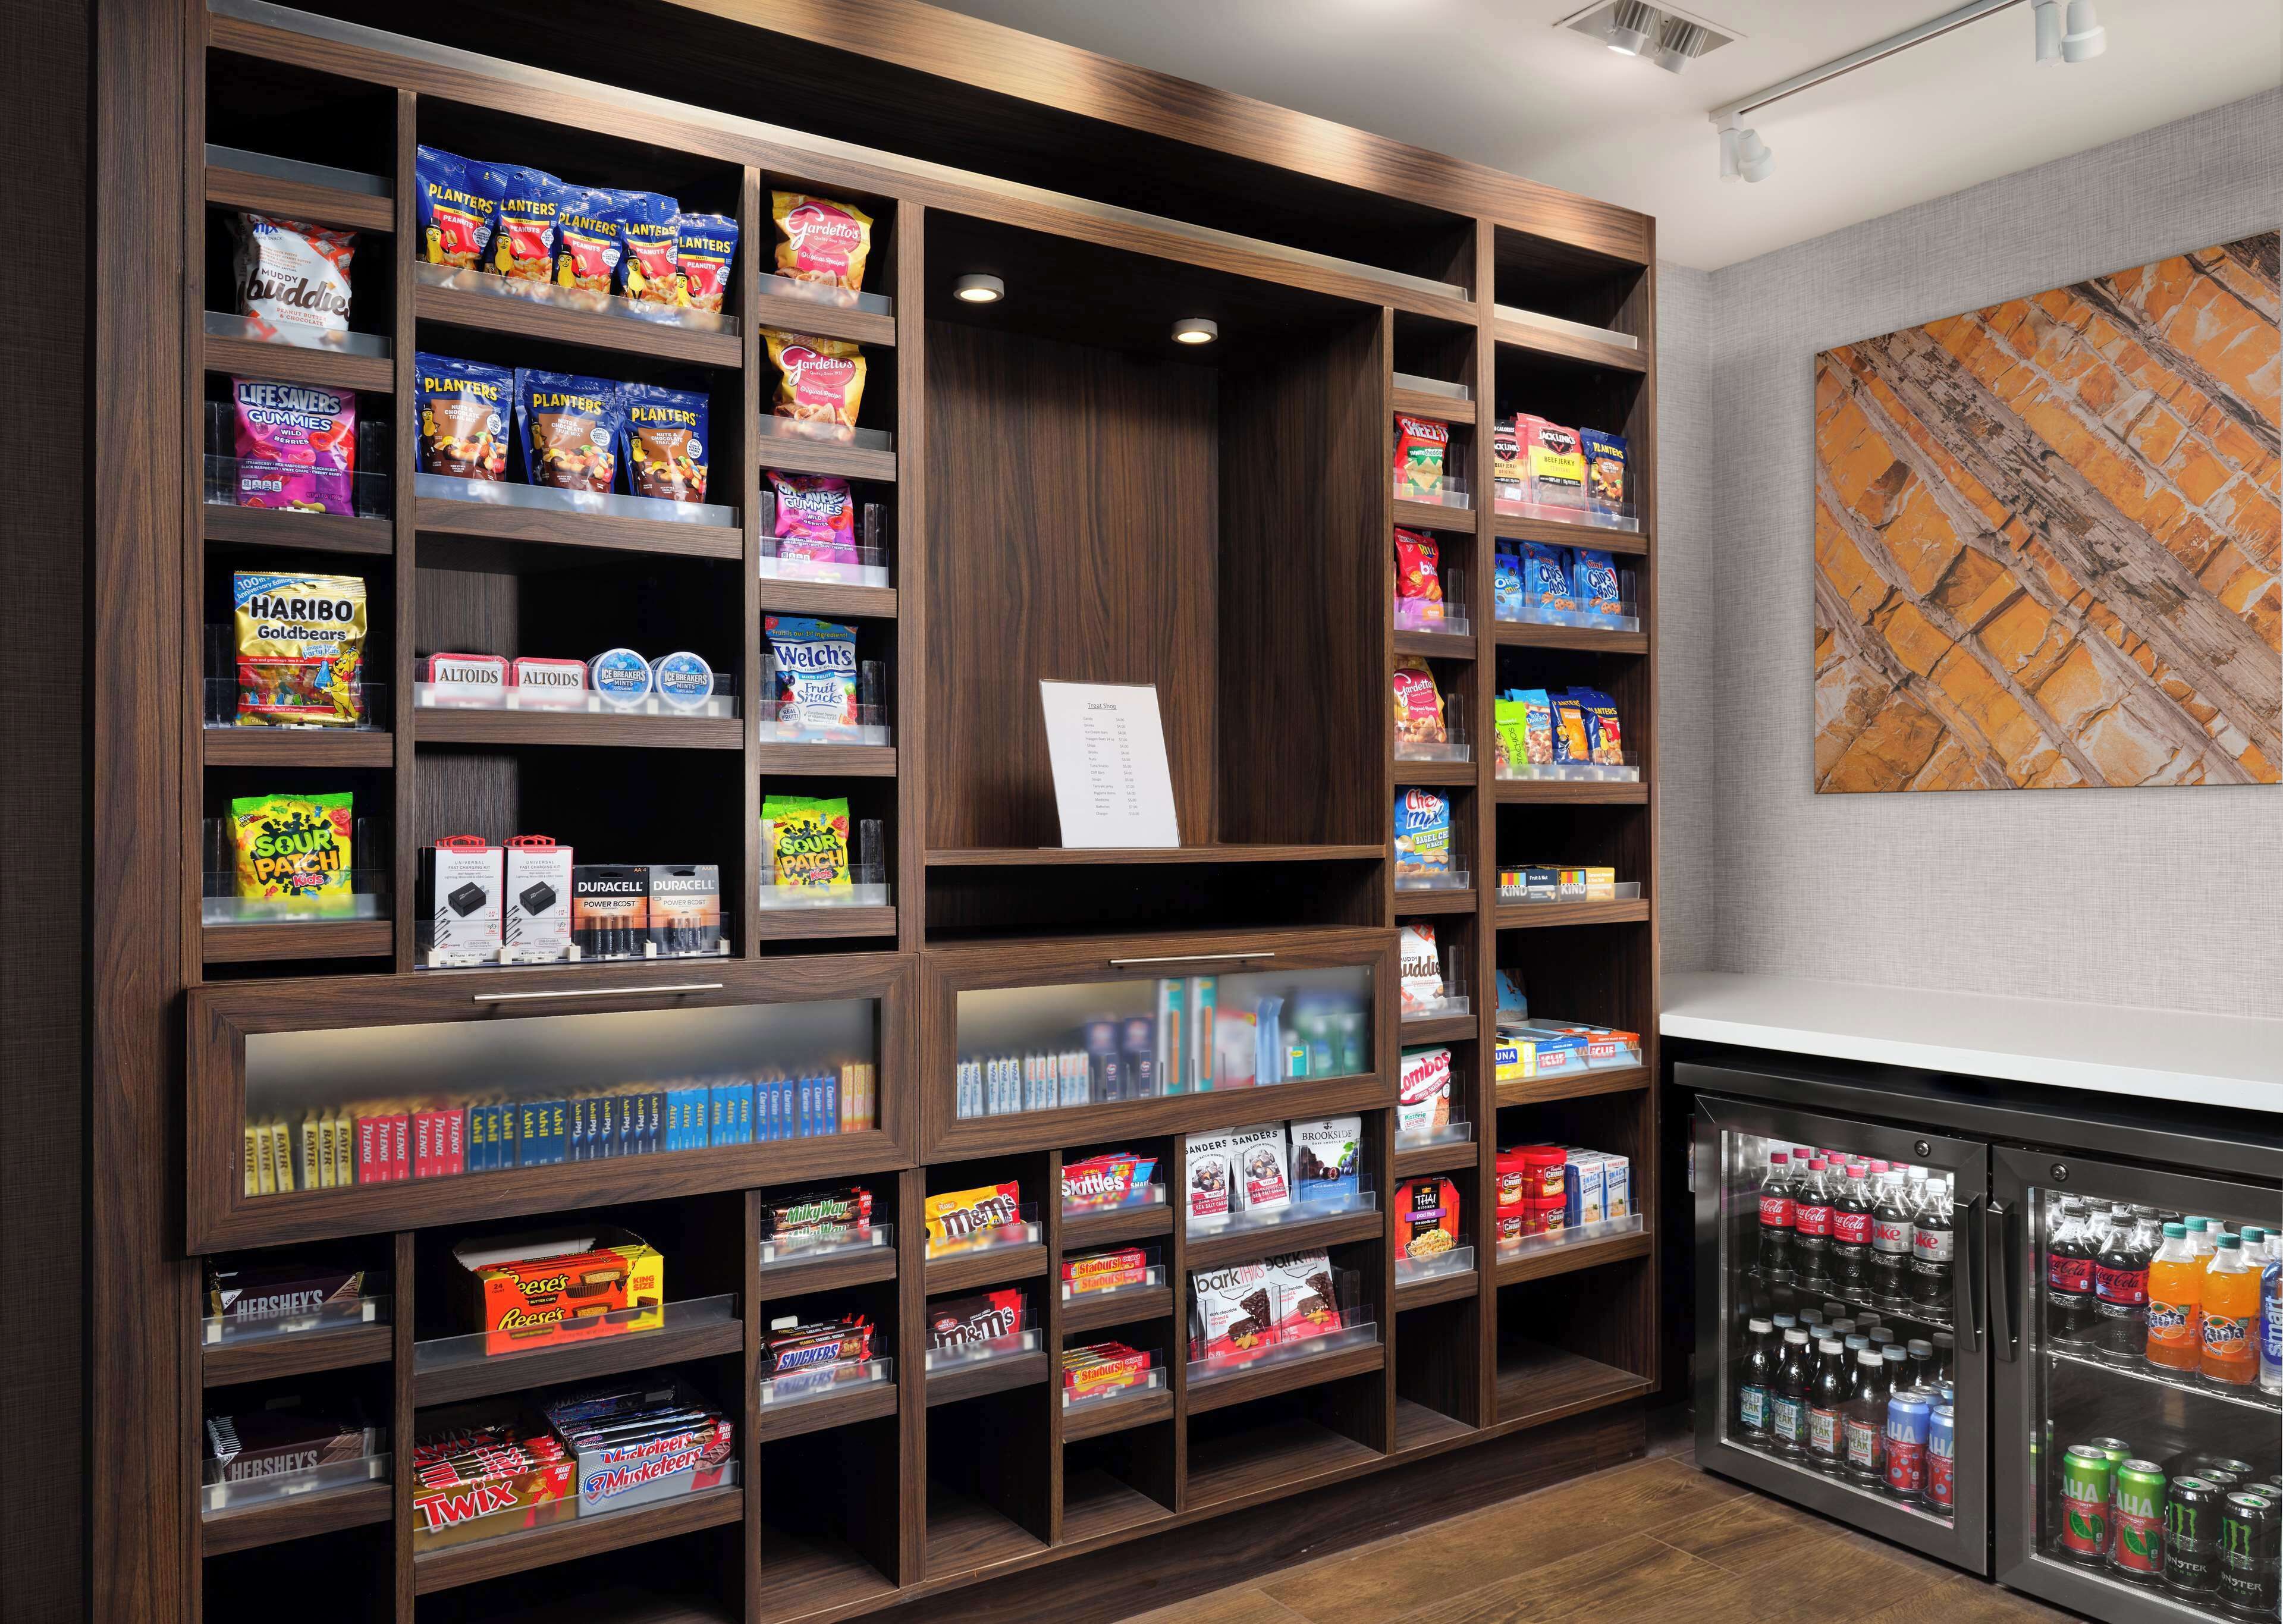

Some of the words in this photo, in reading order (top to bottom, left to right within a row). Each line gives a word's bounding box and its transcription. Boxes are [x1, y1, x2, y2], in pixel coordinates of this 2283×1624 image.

[429, 183, 494, 214] PLANTERS
[443, 215, 474, 229] PEANUTS
[558, 212, 617, 237] PLANTERS
[785, 205, 859, 251] Gardetto's
[572, 240, 601, 252] PEANUTS
[687, 262, 716, 270] PEANUTS
[801, 252, 825, 262] Original
[826, 257, 846, 266] Recipe
[262, 268, 298, 283] MUDDY
[425, 377, 498, 401] PLANTERS
[240, 385, 276, 404] LIFE
[278, 387, 341, 414] SAVERS
[533, 393, 602, 416] PLANTERS
[249, 410, 332, 431] GUMMIES
[445, 409, 480, 420] CHOCOLATE
[631, 407, 696, 426] PLANTERS
[274, 436, 309, 445] BERRIES
[785, 498, 843, 515] GUMMIES
[237, 582, 272, 599] Anniversary
[272, 577, 292, 586] Edition
[238, 577, 266, 590] 100th
[250, 596, 353, 621] HARIBO
[258, 625, 346, 640] Goldbears
[773, 645, 852, 667] Welch's
[439, 668, 499, 684] ALTOIDS
[523, 671, 579, 686] ALTOIDS
[602, 668, 613, 680] ICE
[613, 670, 646, 681] BREAKERS
[665, 671, 675, 682] ICE
[676, 673, 707, 684] BREAKERS
[805, 682, 836, 693] Fruit
[797, 690, 843, 704] Snacks
[1527, 715, 1549, 724] DIAMOND
[255, 829, 332, 857] SOUR
[780, 835, 837, 855] SOUR
[255, 850, 339, 881] PATCH
[781, 849, 844, 875] PATCH
[293, 873, 324, 887] Kids
[810, 869, 833, 881] Kids
[578, 882, 643, 893] DURACELL
[654, 880, 715, 891] DURACELL
[1405, 1111, 1426, 1120] Pizzeria
[488, 1113, 498, 1142] Advil
[525, 1110, 533, 1139] Advil
[379, 1122, 390, 1163] TYLENOL
[1232, 1130, 1278, 1145] SANDERS
[1302, 1129, 1352, 1141] BROOKSIDE
[277, 1133, 288, 1170] BAYER
[362, 1123, 372, 1164] TYLENOL
[1186, 1139, 1227, 1155] SANDERS
[1583, 1173, 1600, 1185] SNACK
[1609, 1168, 1625, 1179] SNACK
[1062, 1174, 1125, 1196] Skittles
[1415, 1193, 1436, 1206] THAI
[941, 1193, 1016, 1236] m&m's
[1874, 1224, 1900, 1240] oke
[1079, 1257, 1120, 1275] Starburst
[509, 1274, 570, 1295] Reese's
[633, 1275, 655, 1286] KING
[633, 1282, 655, 1292] SIZE
[224, 1293, 236, 1306] KING
[236, 1289, 323, 1323] HERSHEY'S
[498, 1307, 565, 1330] Reese's
[935, 1306, 1015, 1347] m&m's
[779, 1343, 841, 1370] SNICKERS
[1125, 1356, 1142, 1364] Original
[1081, 1361, 1123, 1381] Starburst
[718, 1425, 733, 1434] SHARE
[231, 1450, 318, 1481] HERSHEY'S
[555, 1465, 571, 1474] SHARE
[586, 1474, 605, 1500] 3
[605, 1446, 702, 1494] Musketeers
[2166, 1554, 2207, 1573] ONSTER
